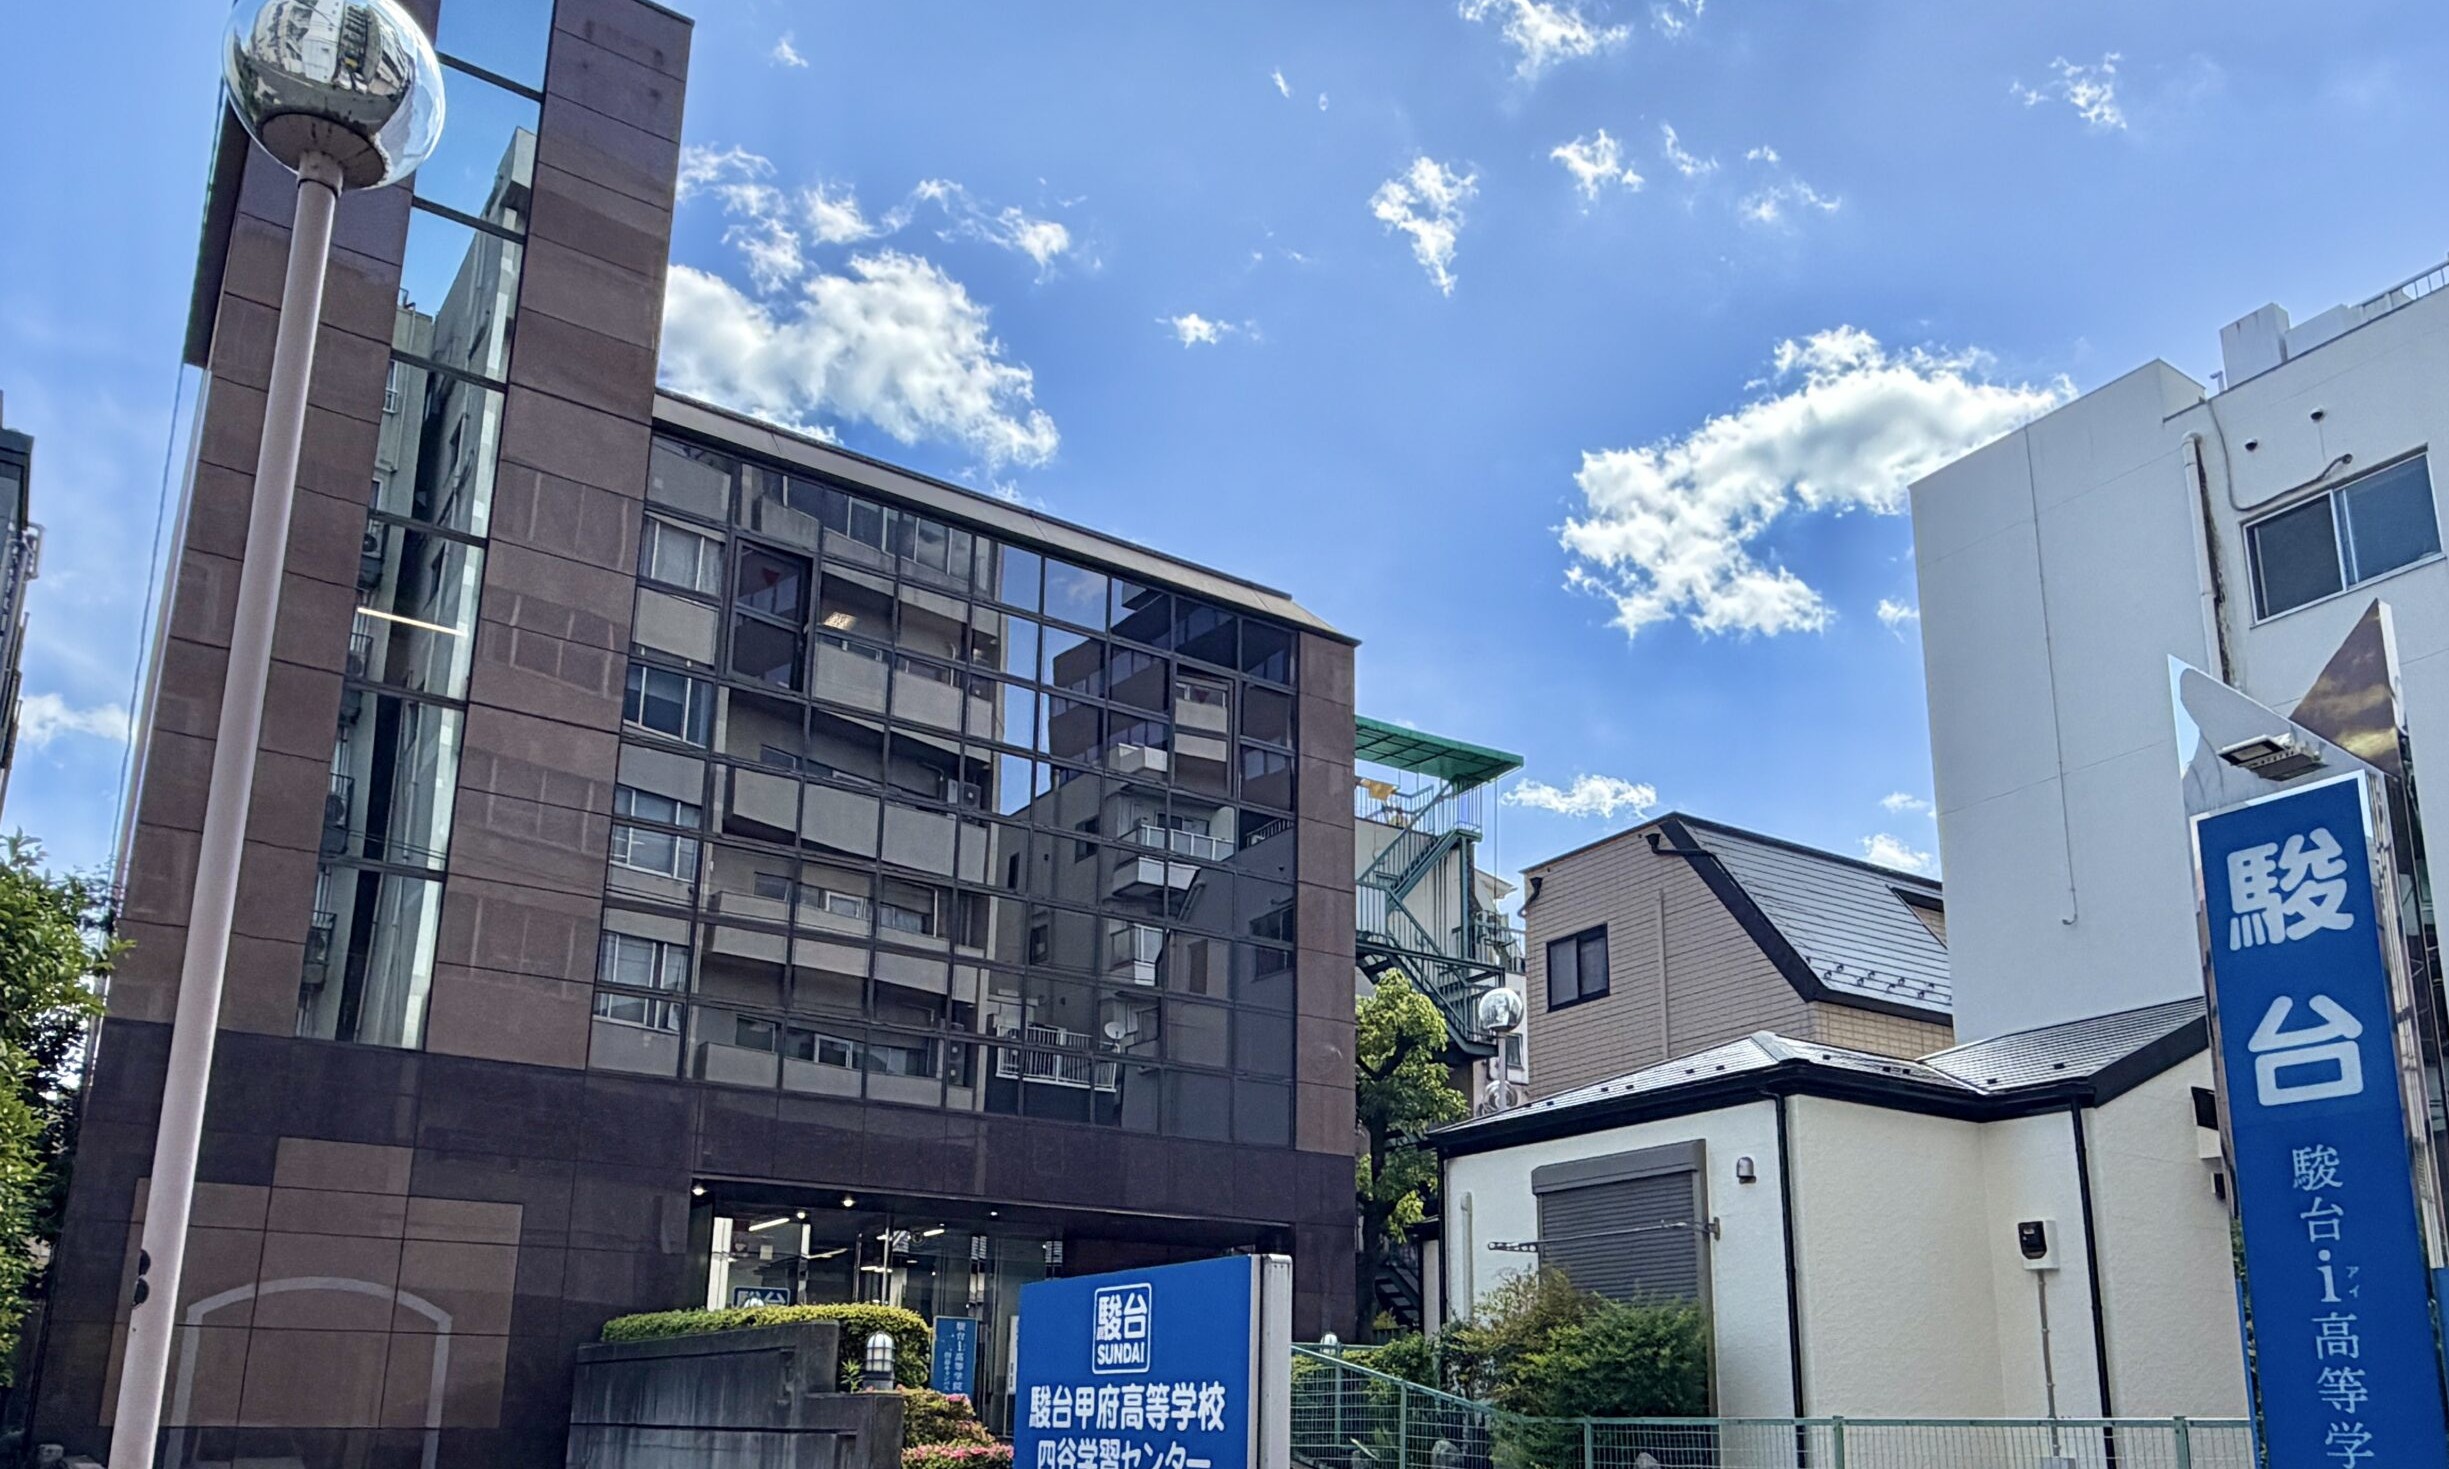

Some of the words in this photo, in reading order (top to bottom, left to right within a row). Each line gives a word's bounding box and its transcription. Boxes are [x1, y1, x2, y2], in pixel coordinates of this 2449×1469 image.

[2227, 827, 2364, 1107] 駿台
[1096, 1292, 1148, 1341] 駿台
[2292, 1143, 2375, 1469] 駿台i高等学
[1096, 1341, 1146, 1365] SUNDAI
[1028, 1380, 1226, 1432] 駿台甲府高等学校
[1037, 1437, 1212, 1469] 四谷学習センター
